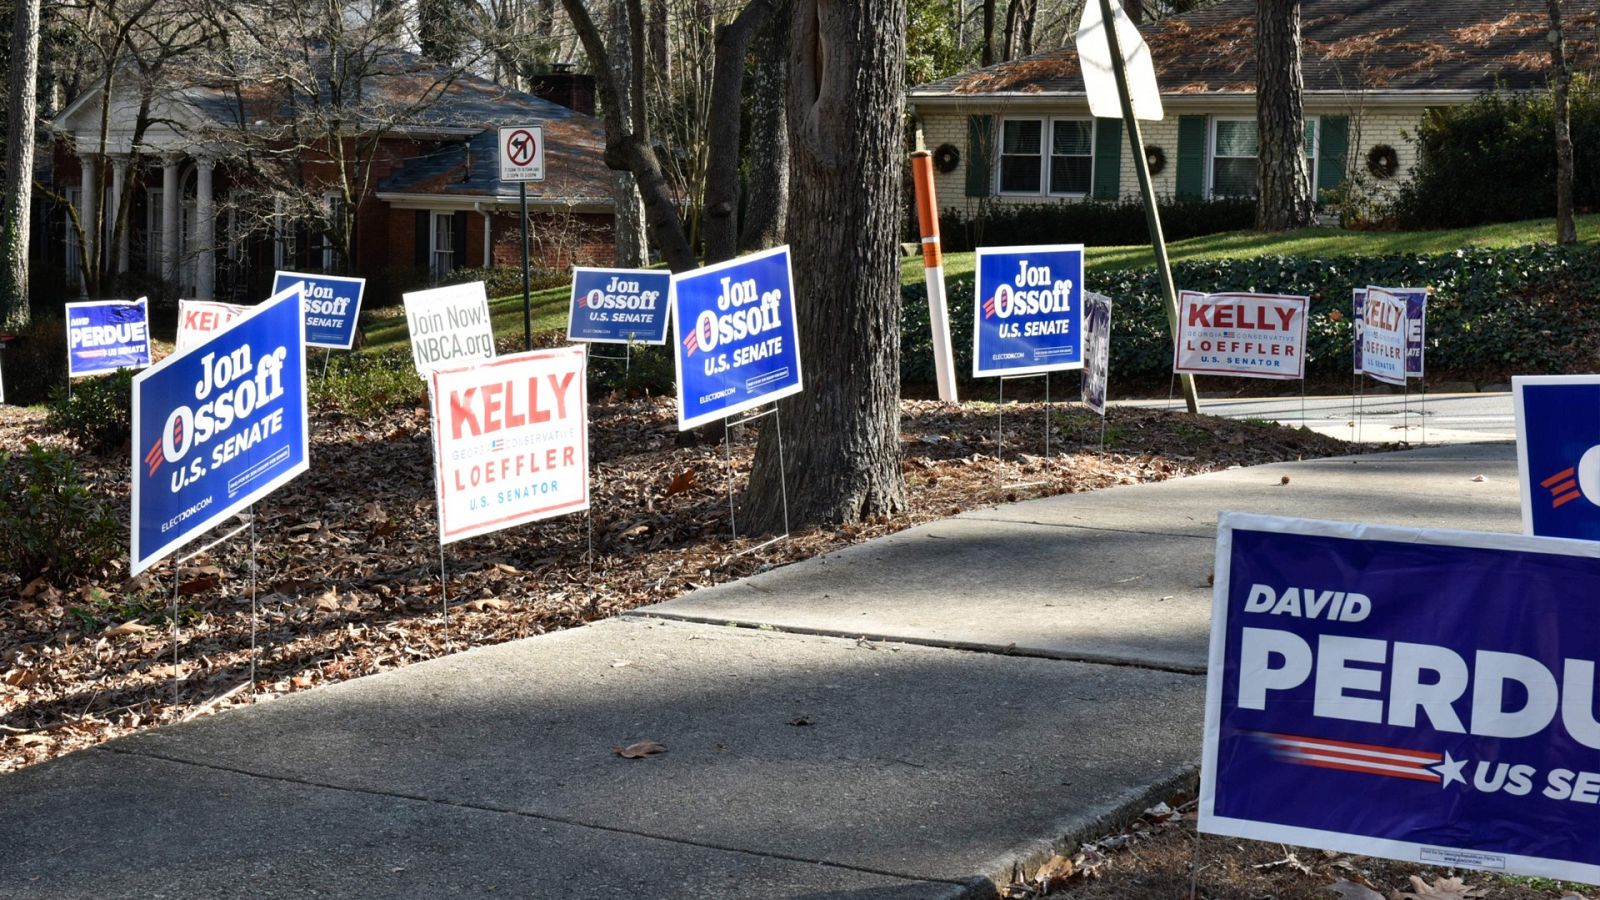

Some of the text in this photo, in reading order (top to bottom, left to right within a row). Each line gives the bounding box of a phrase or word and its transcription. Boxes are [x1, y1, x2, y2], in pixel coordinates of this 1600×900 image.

[606, 276, 639, 293] Jon
[1015, 260, 1051, 287] Jon
[304, 282, 333, 299] Jon
[586, 288, 660, 310] Ossoff
[717, 276, 758, 310] Jon
[994, 280, 1073, 318] Ossoff
[304, 296, 351, 316] ssoff
[412, 300, 488, 337] Join Now!
[589, 312, 654, 323] U.S. SENATE
[695, 288, 782, 352] Ossoff
[1188, 303, 1297, 332] KELLY
[71, 321, 146, 349] PERDUE
[306, 317, 344, 328] SENATE
[999, 319, 1070, 338] U.S. SENATE
[1236, 333, 1295, 342] CONSERVATIVE
[416, 333, 492, 365] NBCA.org
[704, 336, 783, 376] U.S. SENATE
[1187, 340, 1295, 357] LOEFFLER
[1226, 357, 1280, 368] SENATOR
[195, 343, 252, 400] Jon
[162, 345, 287, 463] Ossoff
[450, 371, 576, 440] KELLY
[170, 455, 207, 493] U.S.
[211, 408, 284, 470] SENATE
[452, 445, 491, 461] GEOR
[454, 446, 575, 491] LOEFFLER
[470, 480, 558, 511] U.S. SENATOR
[1244, 584, 1372, 622] DAVID
[1473, 760, 1600, 805] US SE
